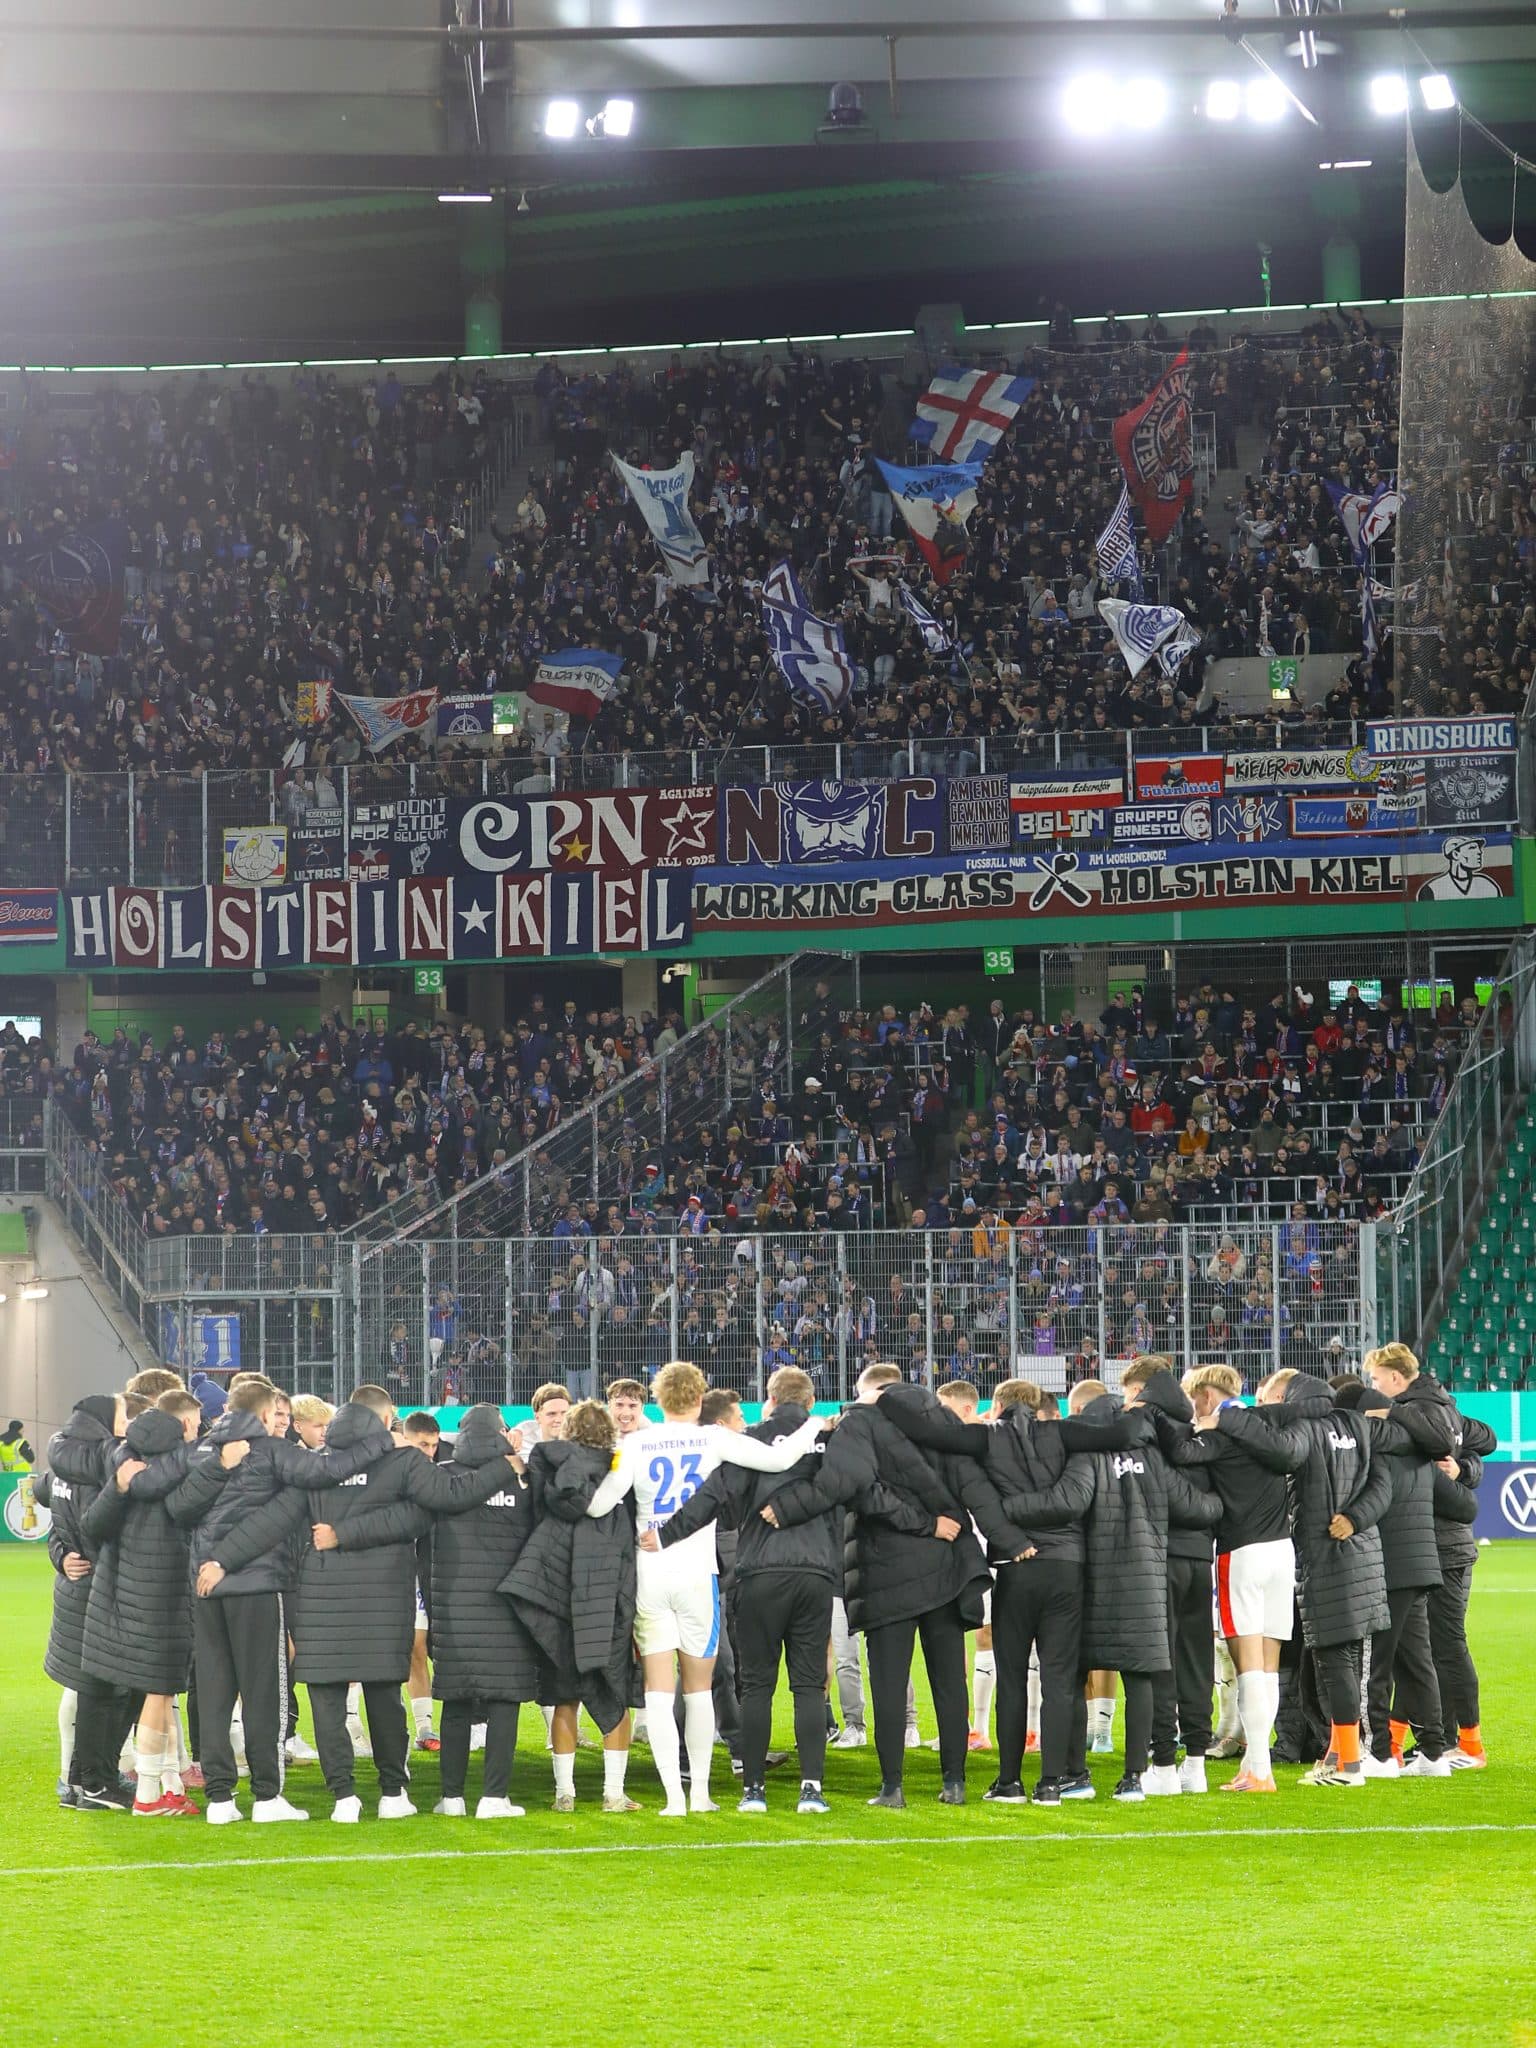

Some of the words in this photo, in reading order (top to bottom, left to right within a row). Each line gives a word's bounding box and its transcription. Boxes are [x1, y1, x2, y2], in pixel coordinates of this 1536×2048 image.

[494, 703, 514, 718] 34
[1374, 722, 1512, 752] RENDSBURG
[1288, 754, 1346, 778] JUNGS
[659, 786, 714, 800] AGAINST
[950, 781, 971, 801] AM
[972, 778, 1009, 800] ENDE
[397, 797, 449, 815] DON'T
[950, 798, 1010, 823] GEWINNEN
[398, 813, 446, 831] STOP
[1115, 809, 1178, 824] GRUPPO
[1456, 808, 1480, 823] Kiel
[351, 823, 390, 841] FOR
[950, 822, 986, 847] IMMER
[987, 820, 1011, 845] WIR
[1114, 823, 1181, 837] ERNESTO
[657, 857, 682, 867] ALL
[686, 854, 716, 865] ODDS
[966, 858, 1007, 870] FUSSBALL
[1009, 856, 1027, 868] NUR
[1089, 854, 1103, 866] AM
[1106, 850, 1167, 866] WOCHENENDE!
[294, 867, 343, 881] ULTRAS
[1099, 855, 1296, 905] HOLSTEIN
[1310, 856, 1404, 895] KIEL
[696, 878, 879, 921] WORKING
[891, 870, 1016, 914] CLASS
[0, 900, 53, 924] Eleven
[71, 886, 446, 961] HOLSTEIN
[508, 878, 685, 947] KIEL
[987, 951, 1011, 967] 35
[418, 970, 441, 987] 33
[641, 1440, 686, 1452] HOLSTEIN
[649, 1453, 705, 1515] 23
